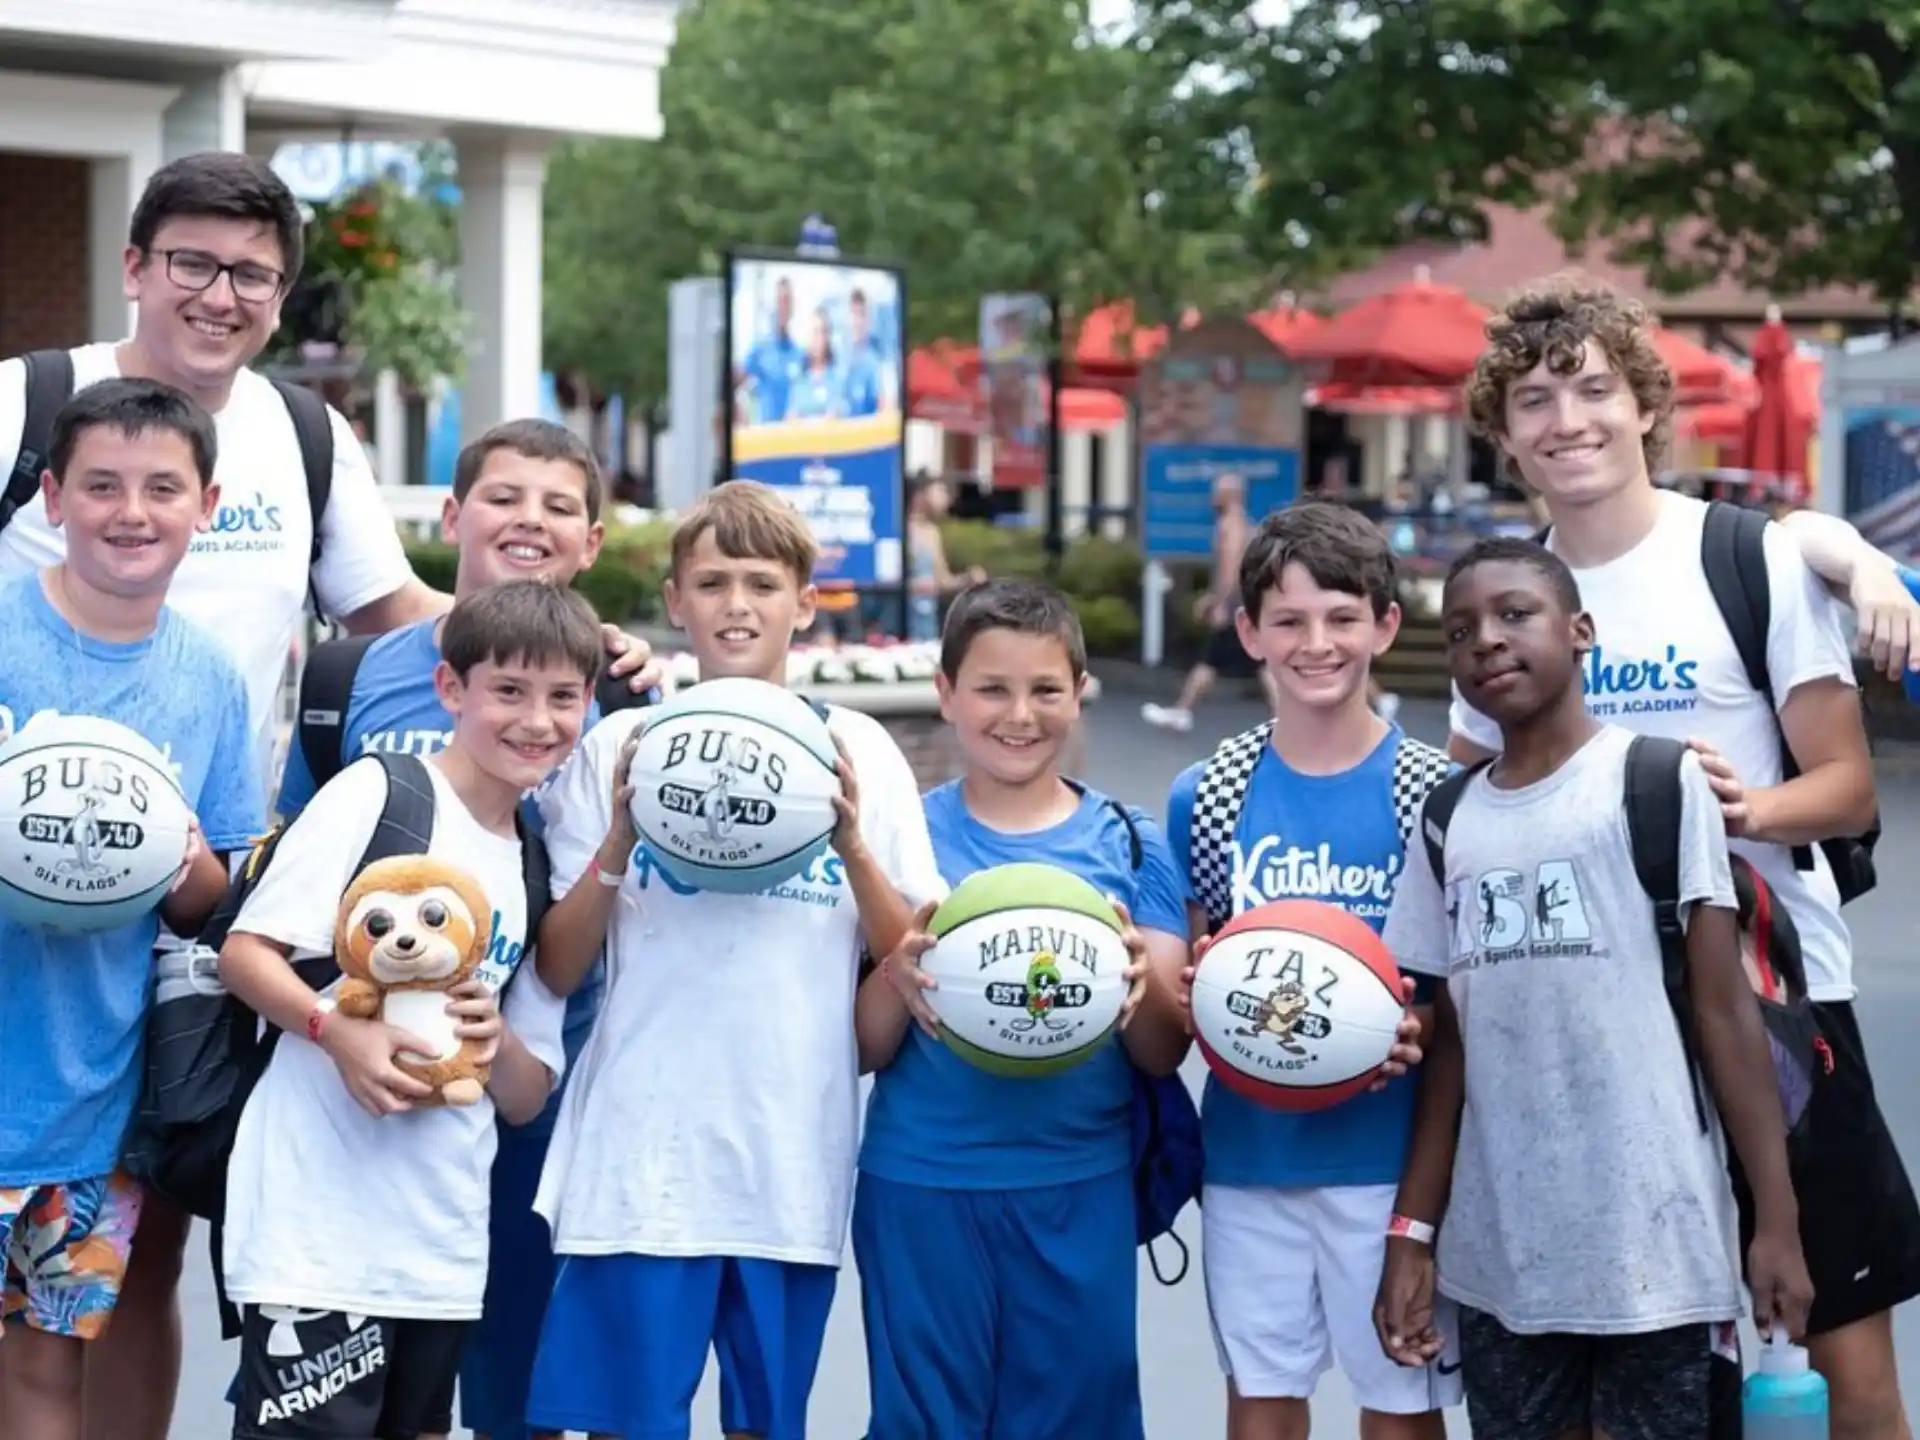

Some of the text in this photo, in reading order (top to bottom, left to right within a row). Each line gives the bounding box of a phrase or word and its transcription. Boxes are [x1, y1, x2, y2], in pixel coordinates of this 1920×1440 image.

[196, 491, 282, 534] er's
[1622, 699, 1697, 714] ACADEMY
[661, 729, 787, 794] BUGS
[20, 757, 150, 815] BUGS
[670, 833, 749, 861] SIX FLAGS
[34, 865, 118, 892] SIX FLAGS
[768, 885, 841, 908] ACADEMY
[1228, 834, 1400, 918] Kutsher'
[978, 925, 1098, 977] MARVIN
[992, 984, 1024, 1006] EST
[1242, 947, 1340, 1009] TAZ
[999, 1027, 1023, 1044] SIX
[277, 1322, 383, 1391] UNDER
[257, 1344, 386, 1426] ARMOUR
